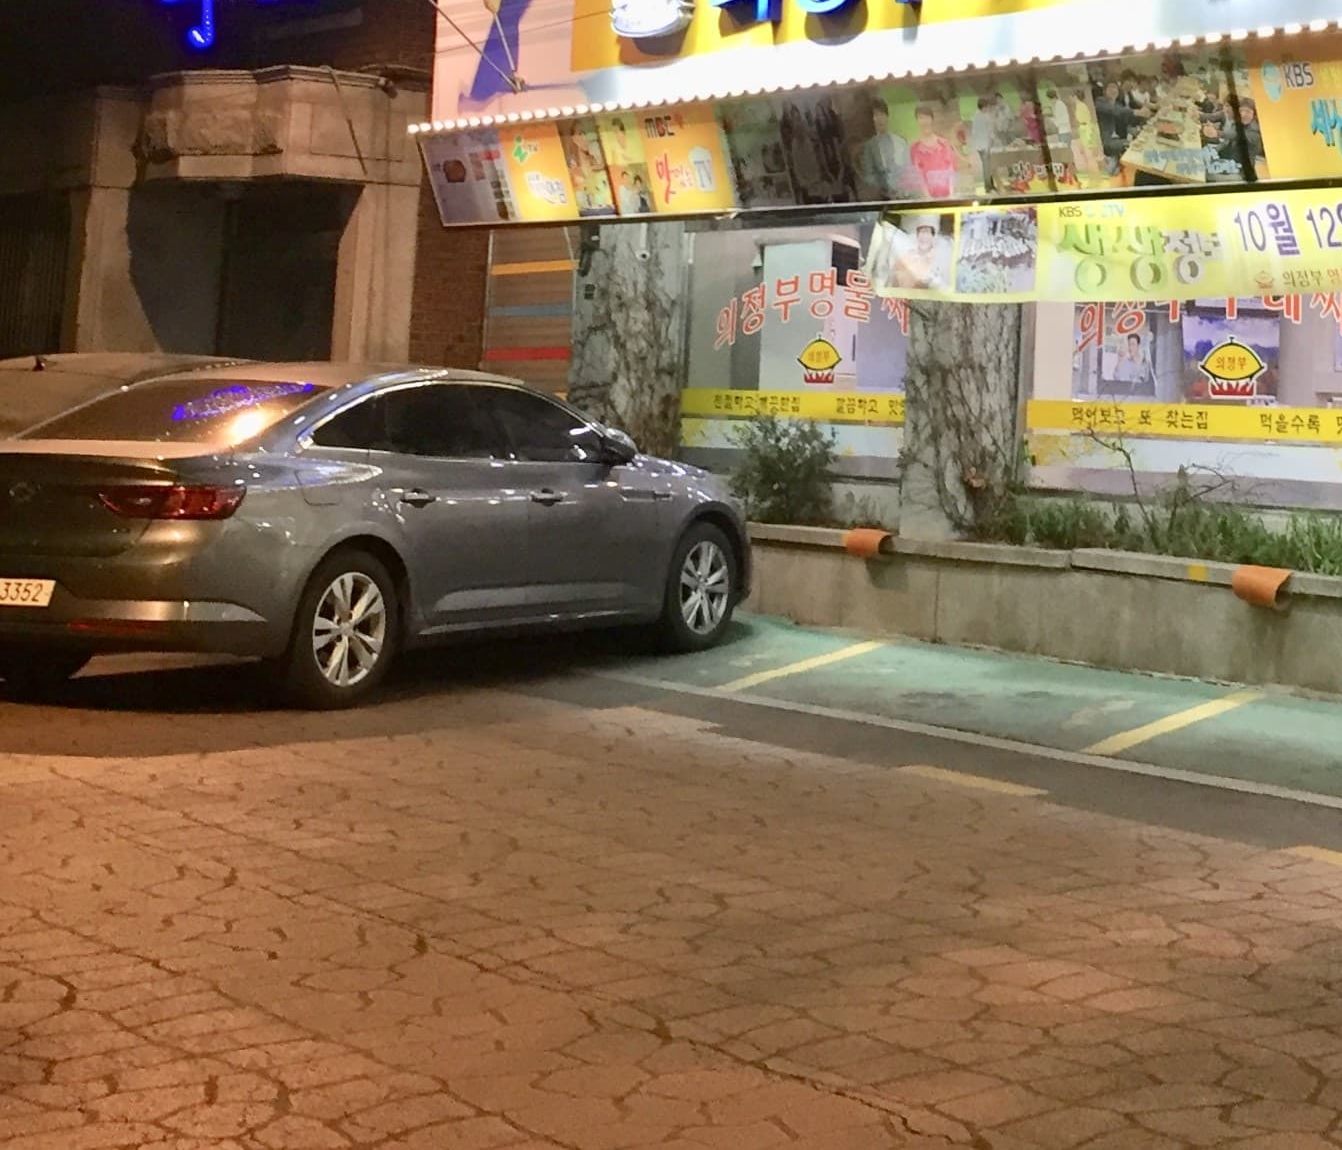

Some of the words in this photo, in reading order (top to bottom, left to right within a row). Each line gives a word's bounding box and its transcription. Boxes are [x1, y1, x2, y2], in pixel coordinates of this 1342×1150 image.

[1283, 61, 1314, 89] KBS
[1058, 206, 1083, 218] KBS
[1233, 203, 1301, 255] 10월
[1282, 268, 1323, 288] 의정부
[1214, 355, 1249, 372] 의정부
[1138, 410, 1152, 426] 또
[1166, 410, 1209, 430] 찾는집
[1259, 412, 1321, 435] 먹을수록
[0, 582, 44, 603] 3352
